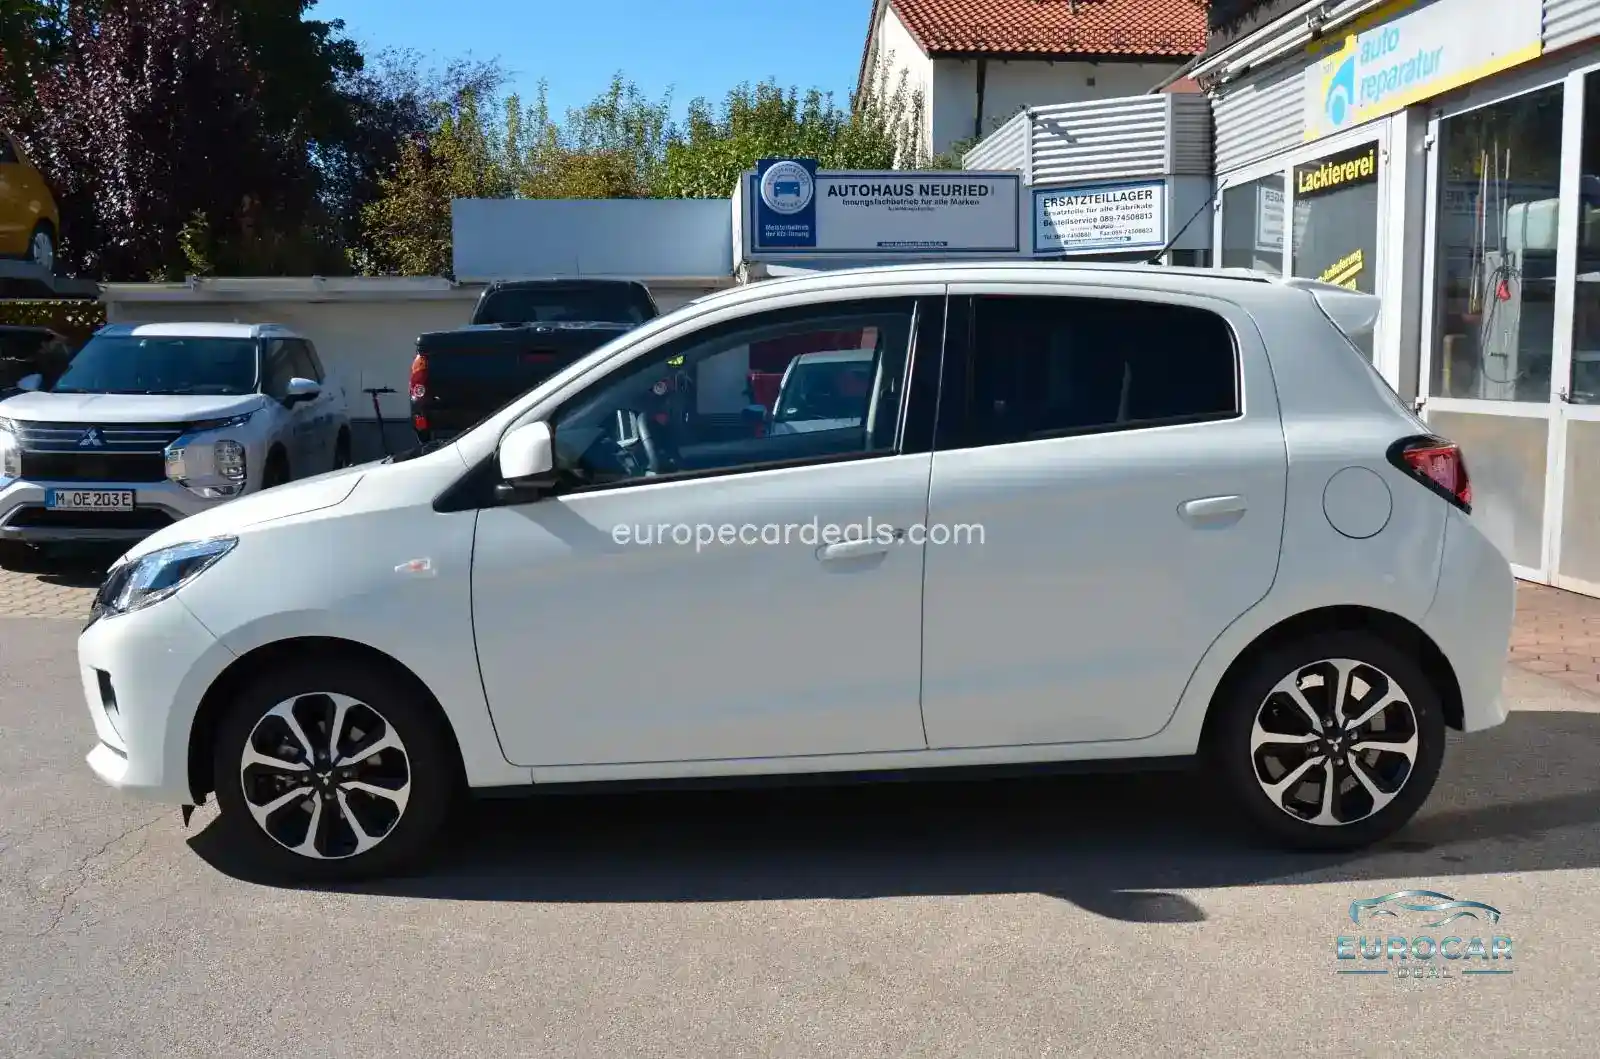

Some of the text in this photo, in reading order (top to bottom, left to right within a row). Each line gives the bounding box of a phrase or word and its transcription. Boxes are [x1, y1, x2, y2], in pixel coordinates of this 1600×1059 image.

[1360, 27, 1400, 66] auto
[1360, 47, 1442, 102] reparatur
[1298, 150, 1375, 193] Lackiererei
[827, 184, 989, 197] AUTOHAUS NEURIED
[1043, 190, 1153, 207] ERSATZTEILLAGER
[1043, 207, 1085, 217] Ersatzteile
[1099, 205, 1114, 213] alle
[1115, 202, 1153, 212] Fabrikate
[1043, 216, 1098, 227] Bestellservice
[55, 492, 65, 505] M
